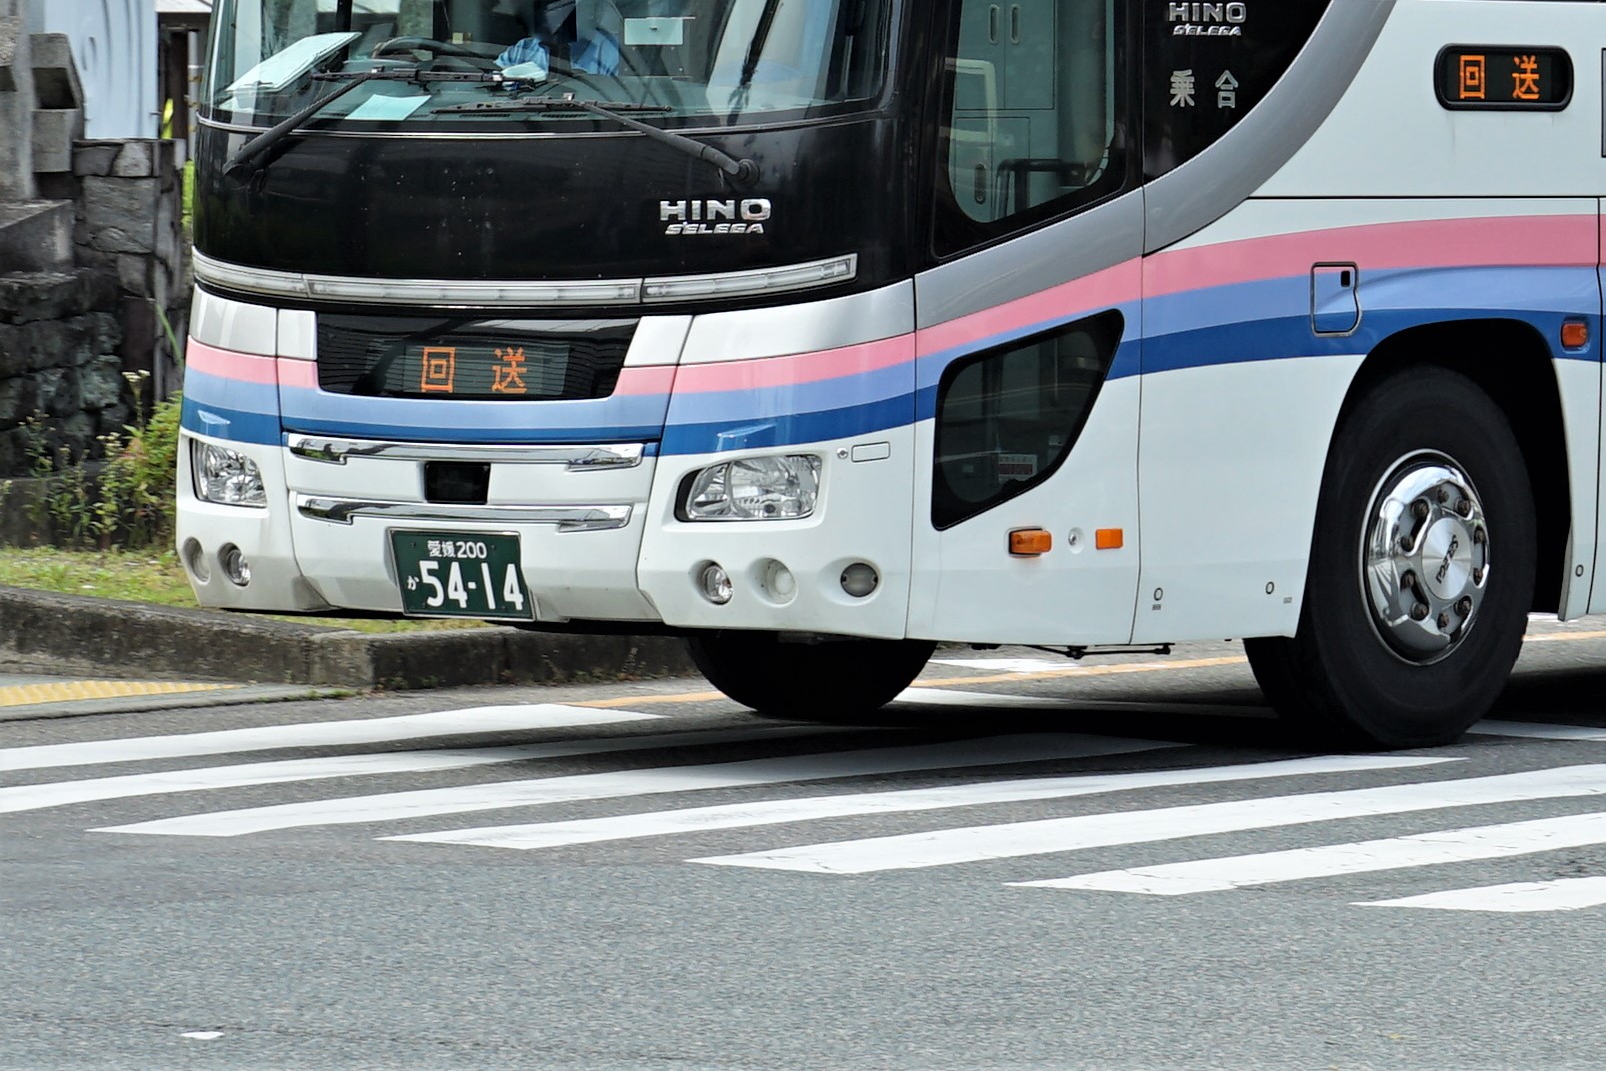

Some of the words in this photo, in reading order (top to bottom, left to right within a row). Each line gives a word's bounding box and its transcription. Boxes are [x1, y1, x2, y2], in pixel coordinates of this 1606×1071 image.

[1168, 2, 1247, 23] HINO
[1169, 69, 1239, 108] 乗合
[1460, 55, 1540, 99] 回送
[660, 198, 771, 221] HINO
[420, 346, 528, 394] 回送
[419, 560, 524, 611] 54-14
